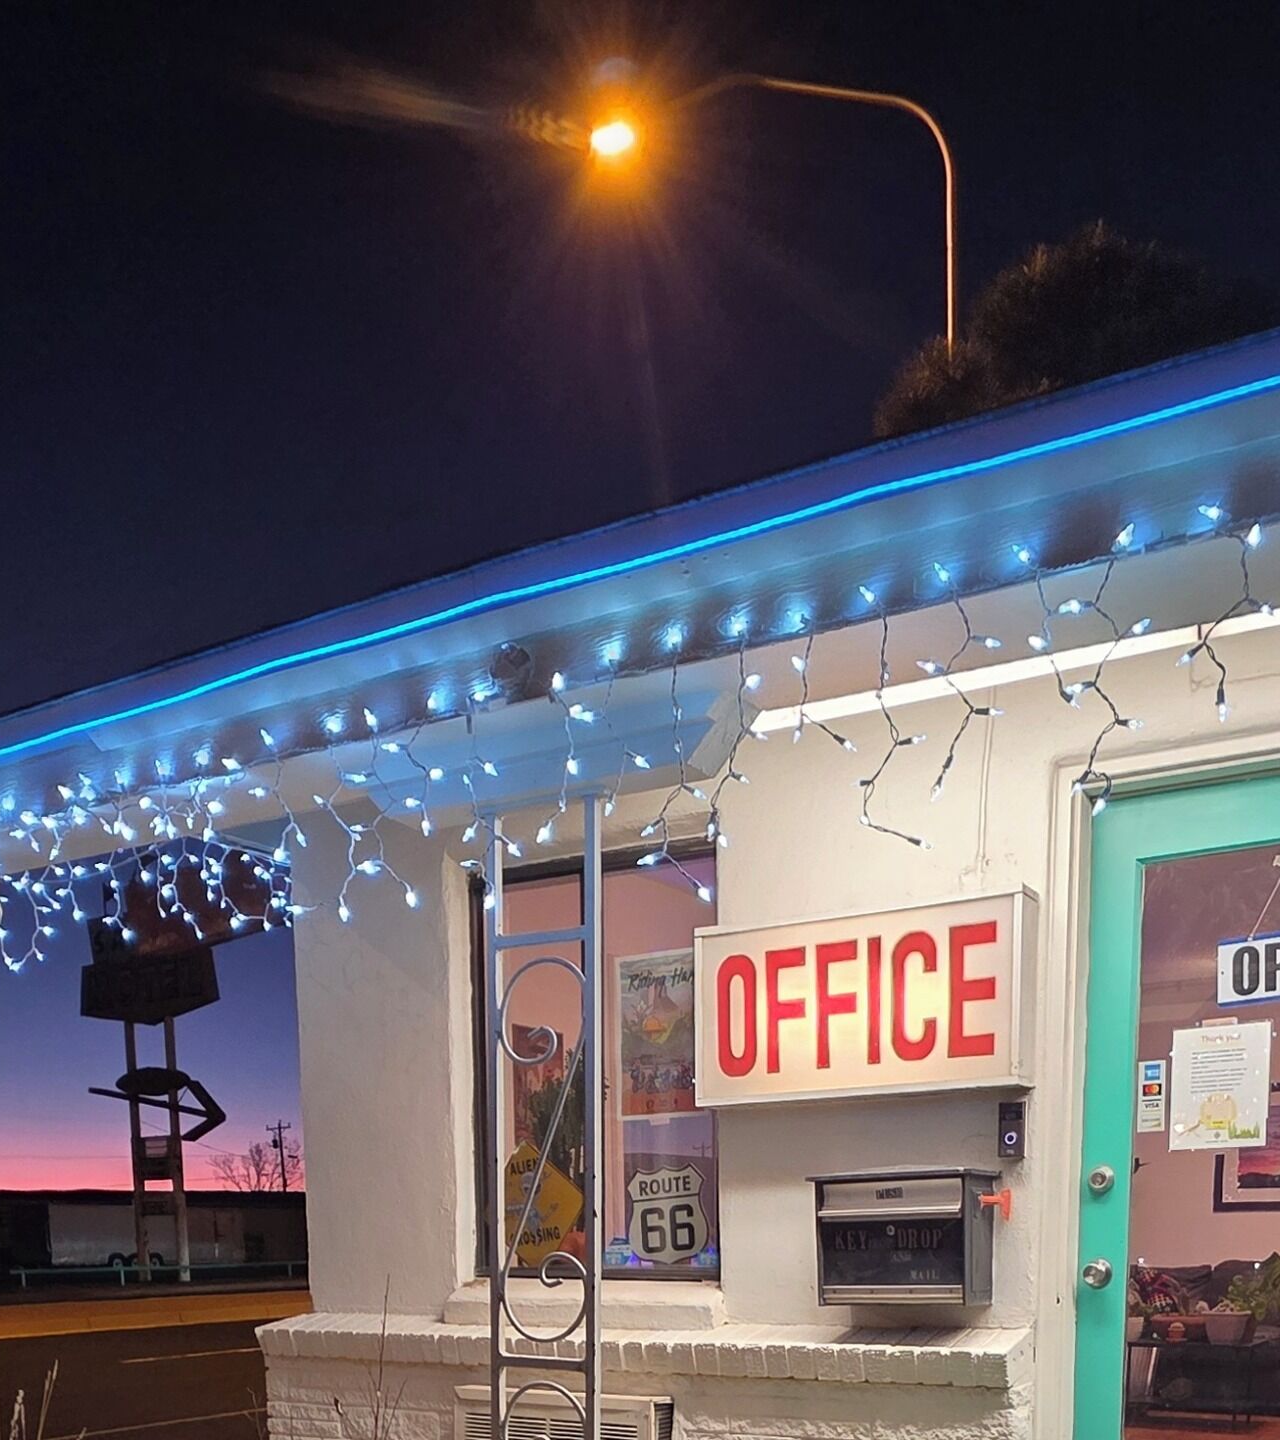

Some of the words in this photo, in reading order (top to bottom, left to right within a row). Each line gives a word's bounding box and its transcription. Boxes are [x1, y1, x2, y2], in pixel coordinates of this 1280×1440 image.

[628, 970, 666, 997] Riding
[716, 920, 997, 1077] OFFICE
[1144, 1102, 1160, 1110] VISA
[510, 1157, 539, 1176] ALIEN
[639, 1175, 692, 1197] ROUTE
[640, 1203, 696, 1254] 66
[835, 1230, 869, 1250] KEY
[897, 1228, 943, 1249] DROP
